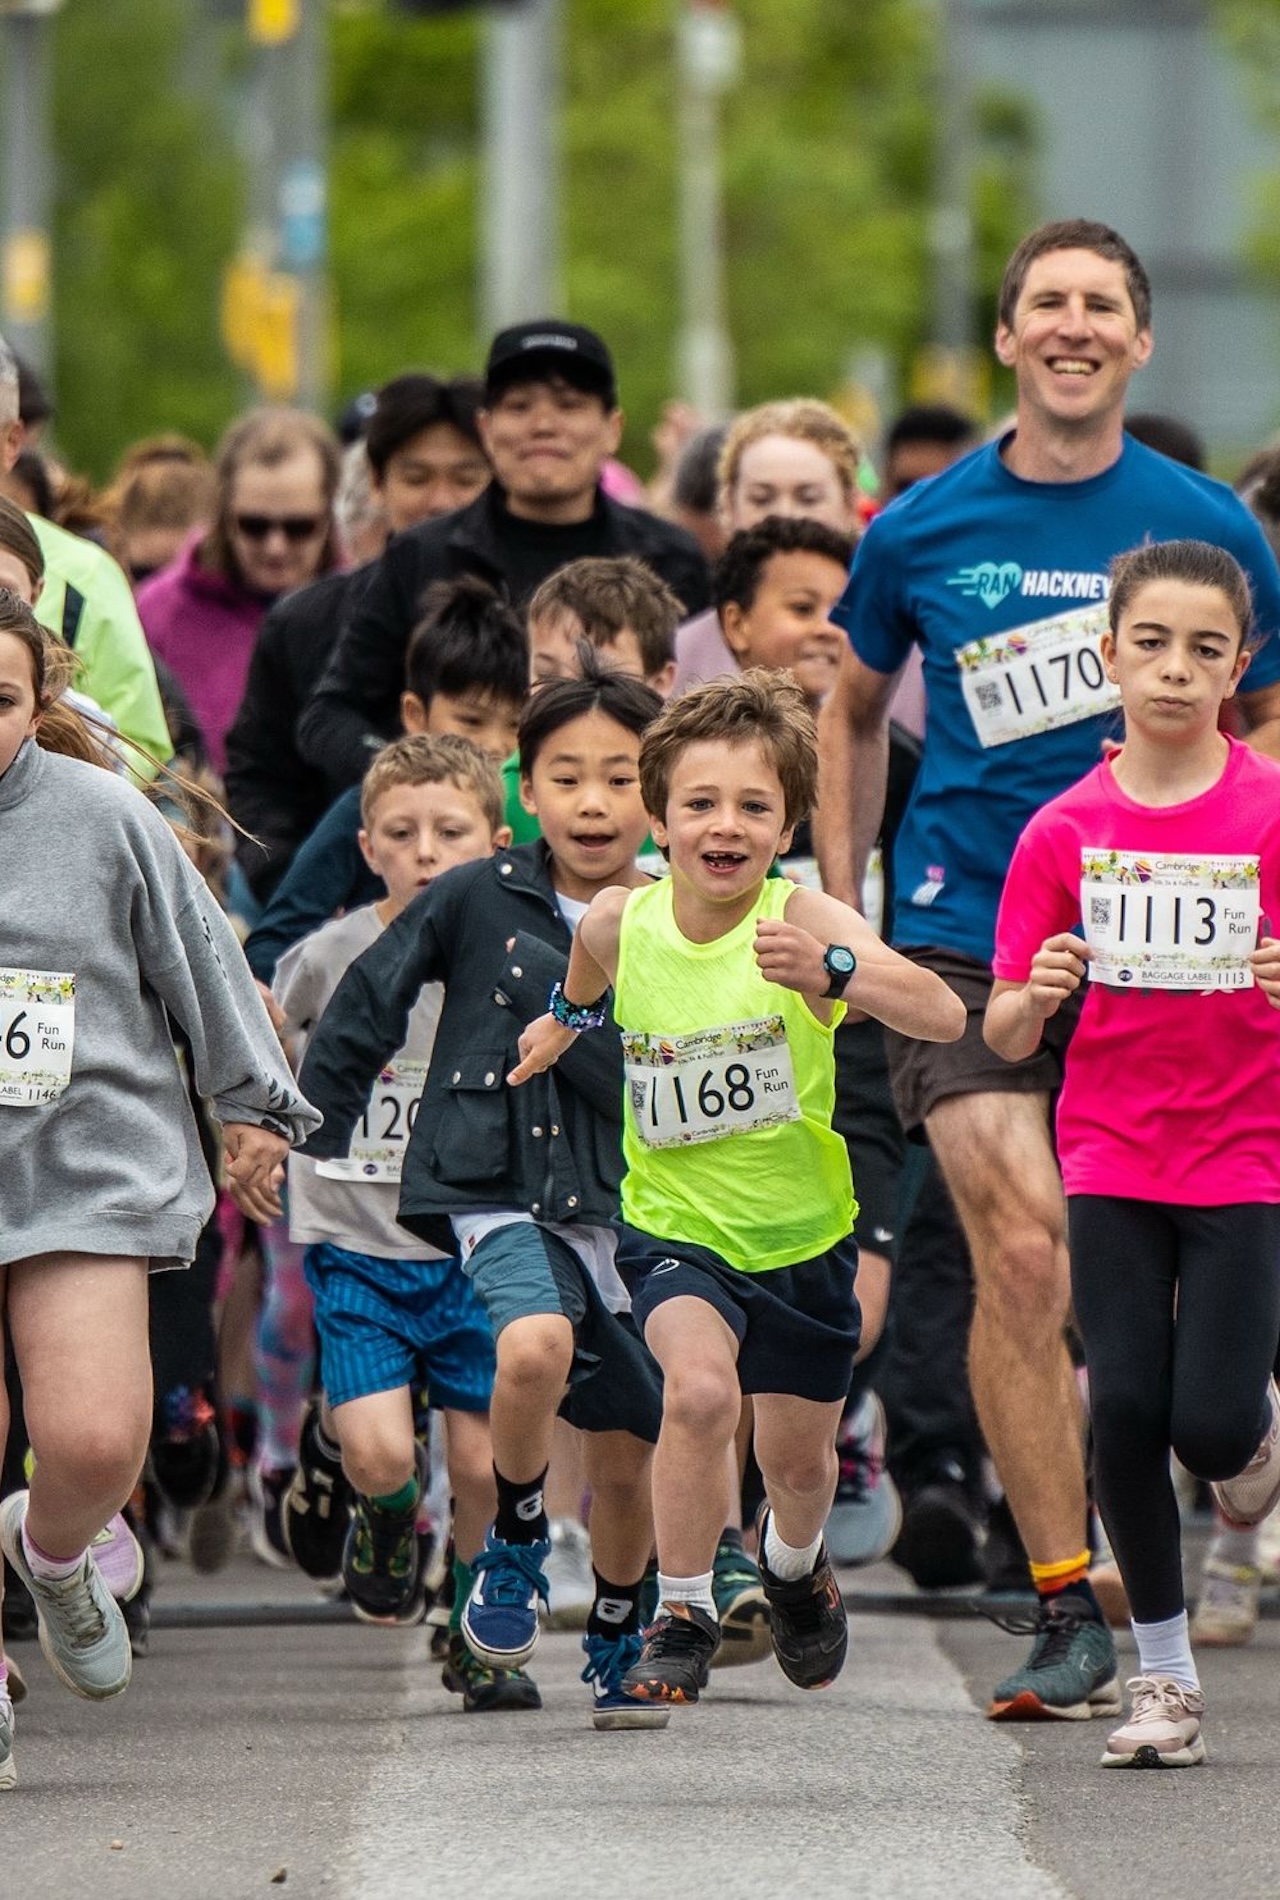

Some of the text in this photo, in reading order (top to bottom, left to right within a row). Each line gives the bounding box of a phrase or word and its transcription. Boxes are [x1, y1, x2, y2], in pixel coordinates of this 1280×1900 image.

[978, 573, 1016, 594] RAN
[1005, 647, 1104, 715] 1170
[1119, 894, 1245, 945] 1113 Fun
[1229, 923, 1251, 934] Run
[1142, 971, 1185, 981] BAGGAGE
[1187, 973, 1212, 981] LABEL
[1217, 972, 1245, 984] 1113
[37, 1022, 60, 1035] Fun
[42, 1038, 66, 1051] Run
[676, 1033, 722, 1050] Cambridge
[763, 1080, 789, 1093] Run
[28, 1089, 56, 1101] 1146
[652, 1064, 779, 1126] 1168 Fun
